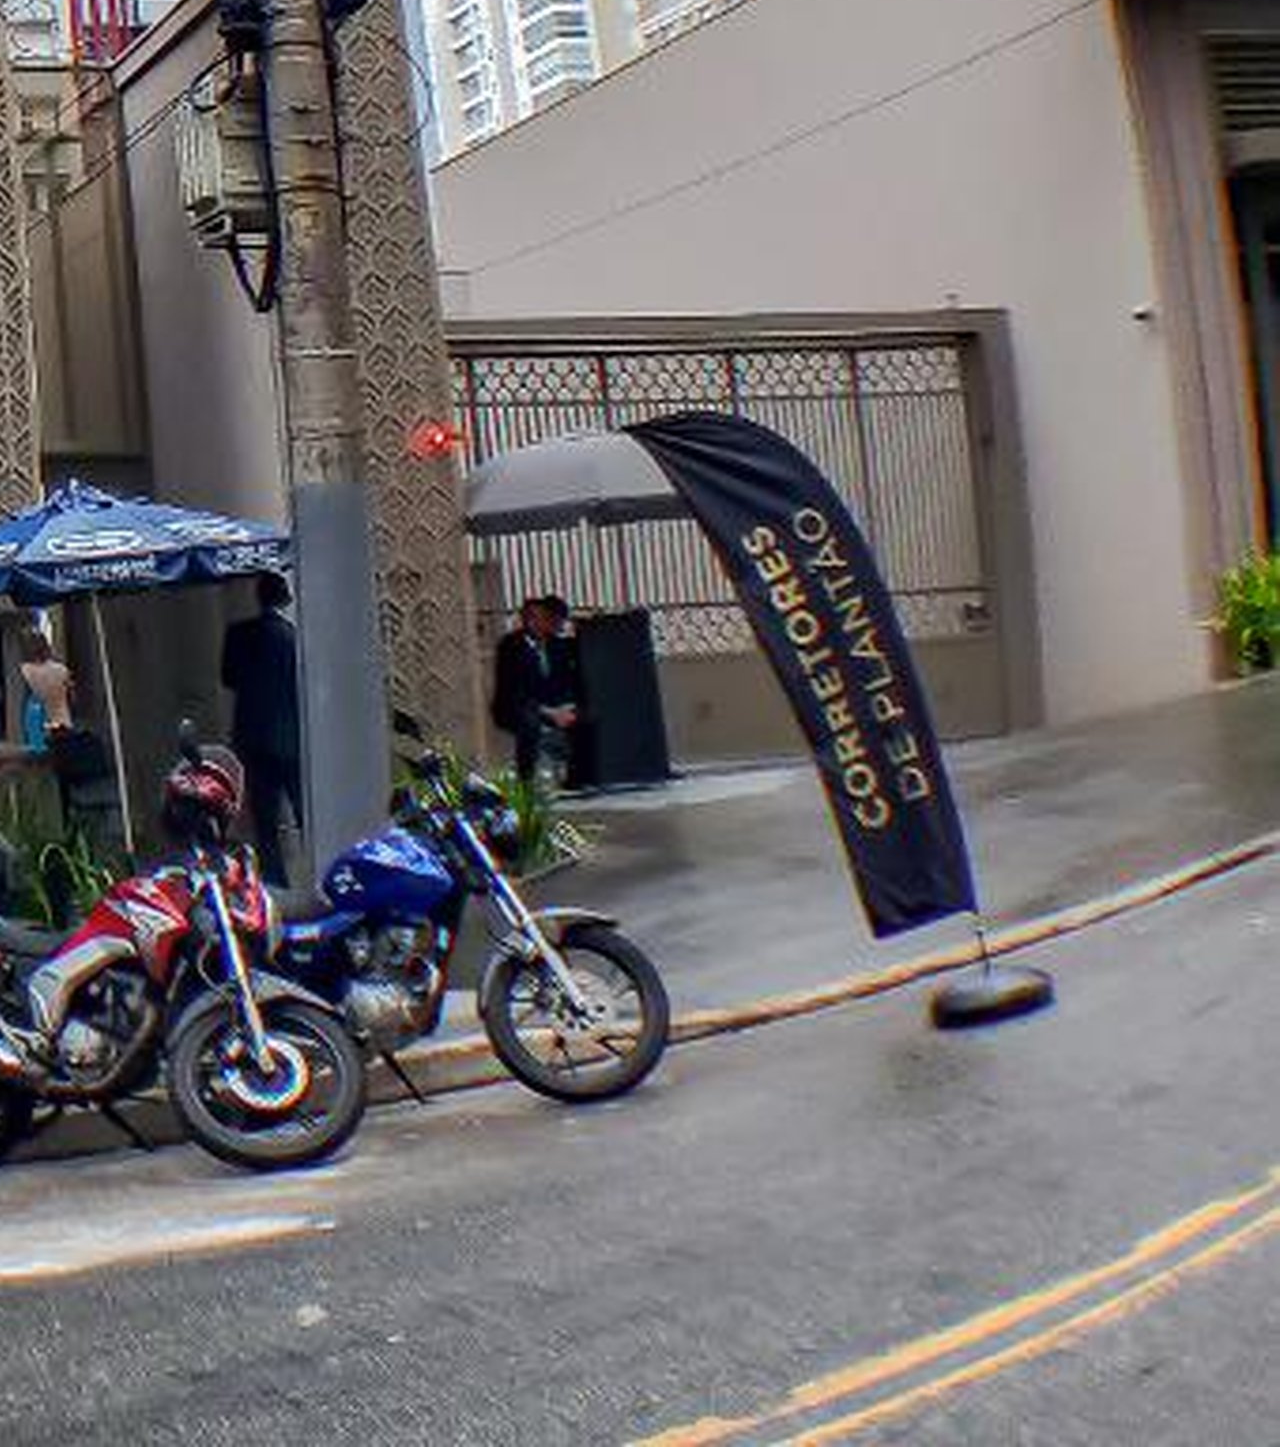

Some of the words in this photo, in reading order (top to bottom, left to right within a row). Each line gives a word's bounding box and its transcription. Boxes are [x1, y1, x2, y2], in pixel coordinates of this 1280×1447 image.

[742, 526, 891, 828] CORRETORES
[793, 507, 905, 723] PLANTÃO
[888, 731, 929, 801] DE
